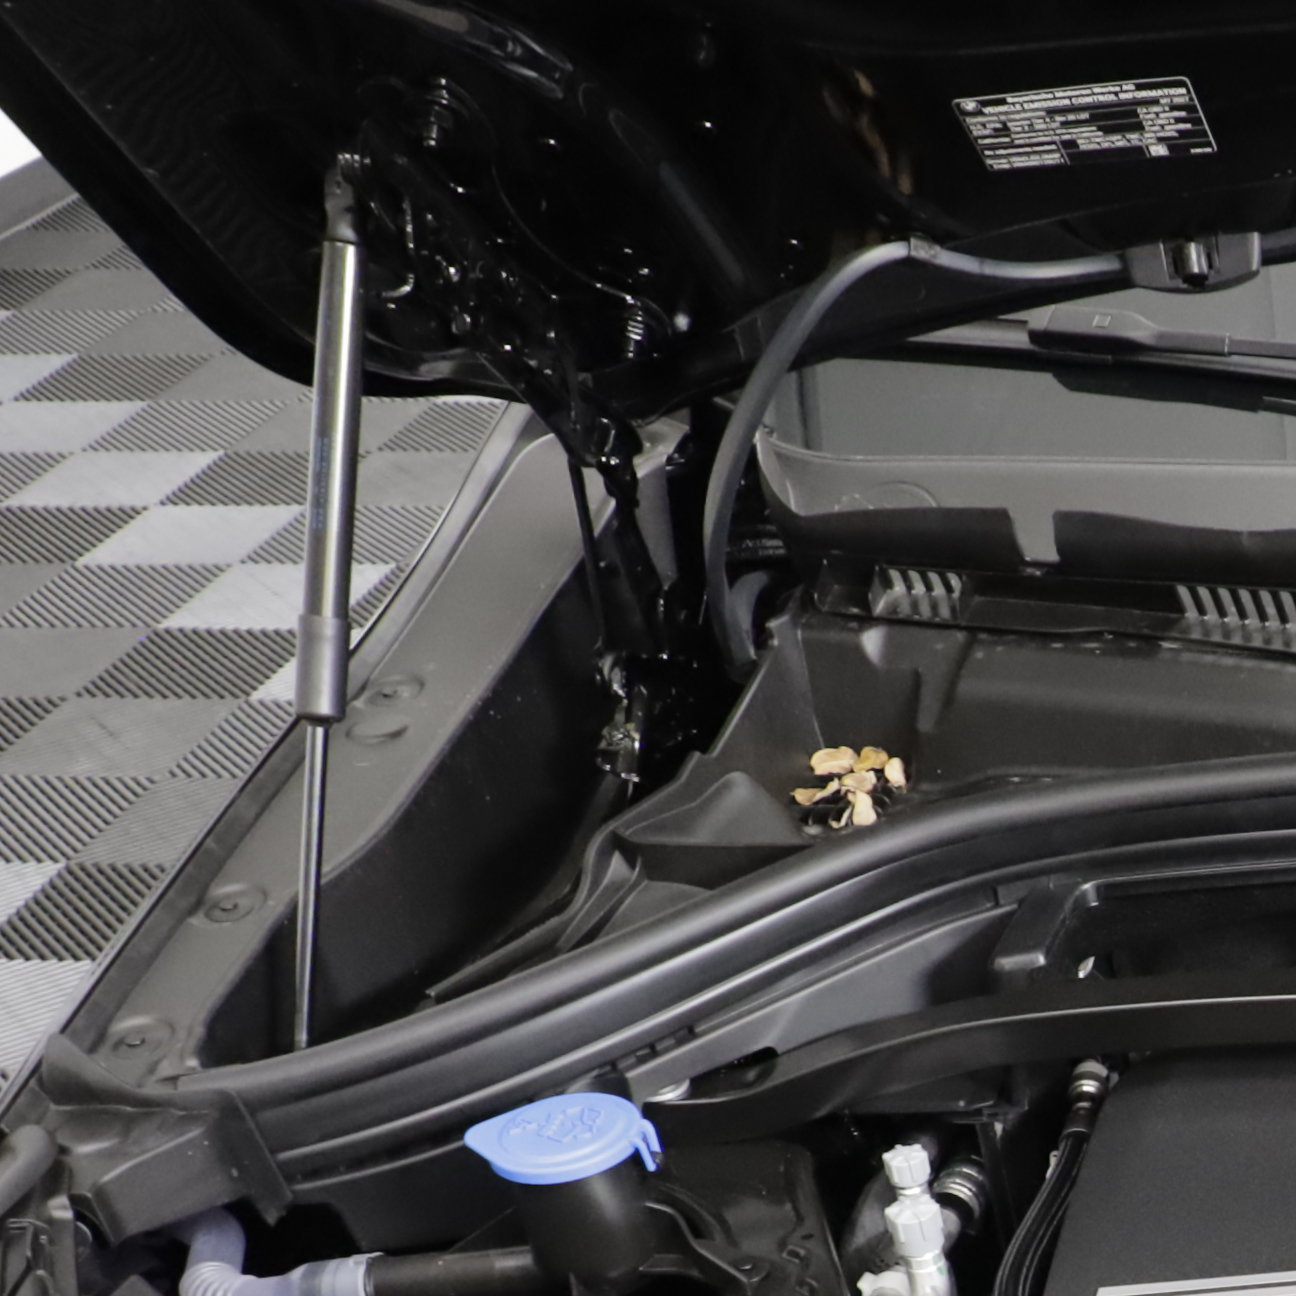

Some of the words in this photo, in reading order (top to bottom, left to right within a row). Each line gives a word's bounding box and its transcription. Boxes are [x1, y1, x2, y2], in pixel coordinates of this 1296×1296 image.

[981, 103, 1023, 114] VEHICLE
[1022, 98, 1071, 110] EMISSION
[1071, 93, 1119, 105] CONTROL
[1118, 87, 1188, 100] INFORMATION
[1054, 89, 1092, 98] Motoren
[1092, 85, 1121, 94] Werke
[1121, 83, 1136, 91] AG
